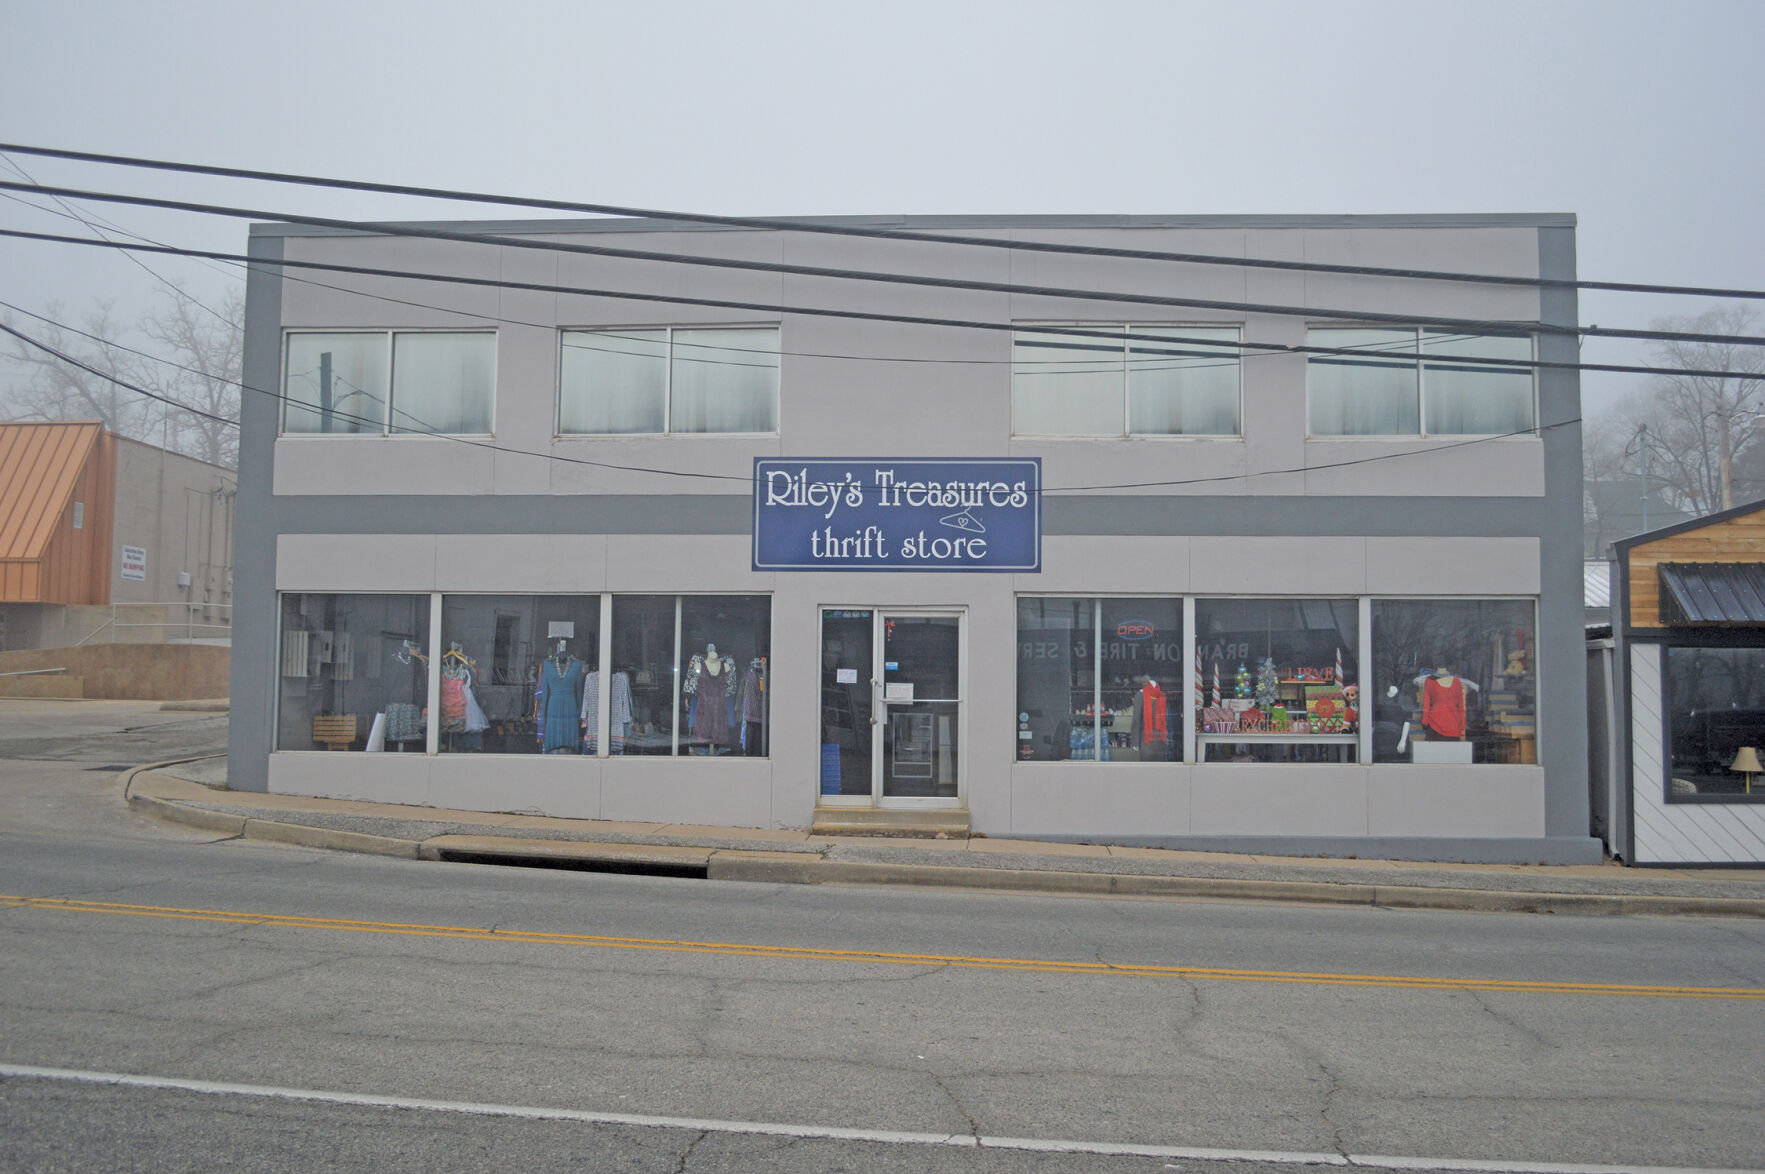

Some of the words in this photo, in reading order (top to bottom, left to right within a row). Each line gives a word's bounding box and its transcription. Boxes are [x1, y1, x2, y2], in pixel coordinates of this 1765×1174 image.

[765, 468, 863, 519] Riley's
[875, 469, 1028, 508] Treasures
[811, 525, 889, 559] thrift
[900, 530, 987, 559] store
[1117, 624, 1154, 636] OPEN
